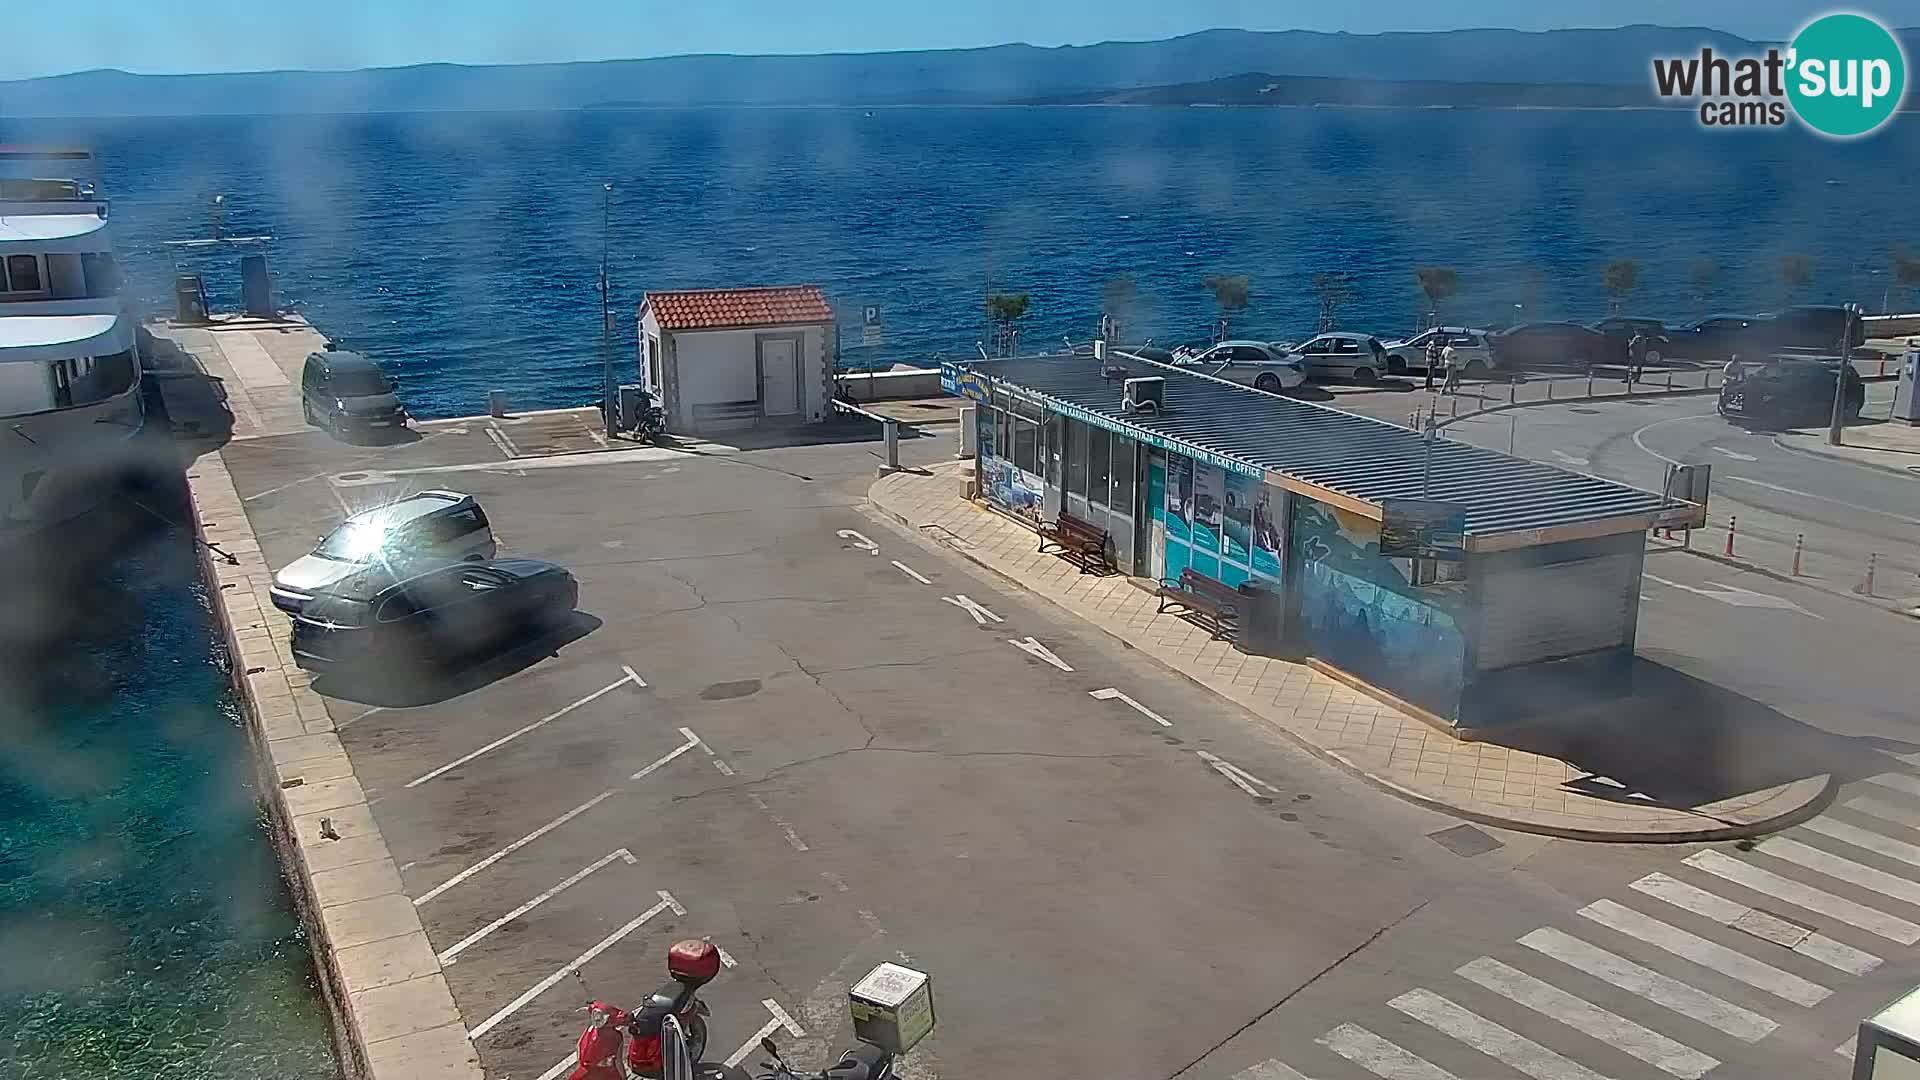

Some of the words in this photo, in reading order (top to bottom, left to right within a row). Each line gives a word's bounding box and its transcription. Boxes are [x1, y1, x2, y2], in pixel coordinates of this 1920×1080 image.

[866, 307, 876, 323] P
[1088, 415, 1125, 433] AUTOBUSNA
[1125, 427, 1154, 444] POSTAJA
[1163, 439, 1177, 451] BUS
[1178, 444, 1207, 460] STATION
[1210, 454, 1234, 469] TICKET
[1235, 463, 1261, 477] OFFICE
